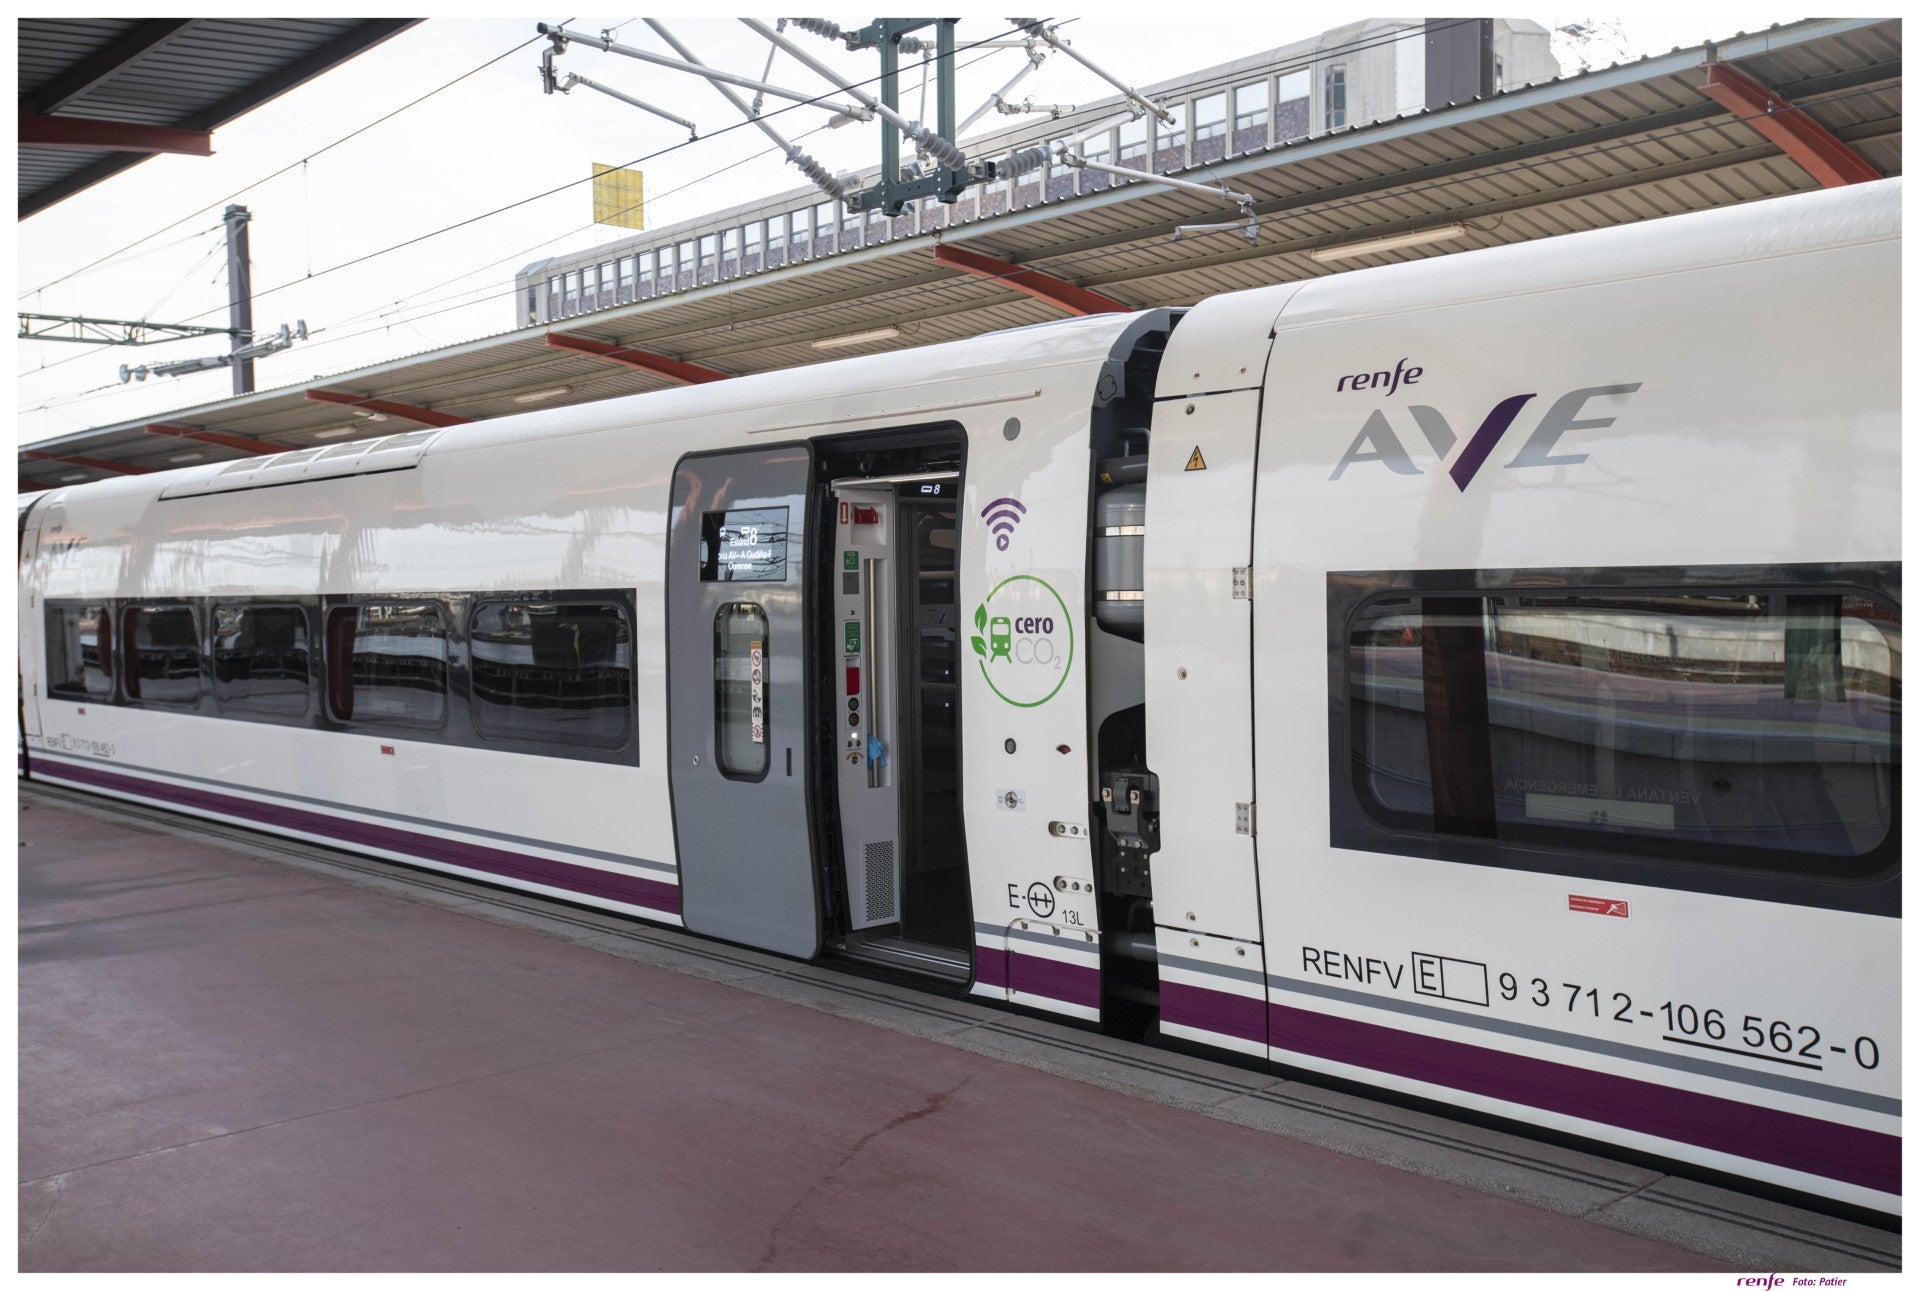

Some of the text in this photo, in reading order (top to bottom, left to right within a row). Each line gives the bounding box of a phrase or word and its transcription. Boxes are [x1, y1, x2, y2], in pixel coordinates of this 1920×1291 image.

[1336, 357, 1424, 397] renfe
[1327, 381, 1645, 493] AVE
[933, 484, 941, 494] 8
[749, 527, 757, 545] 8
[1015, 616, 1054, 634] cero
[1062, 909, 1084, 926] 13L
[1302, 946, 1404, 989] RENFV
[1419, 958, 1437, 991] E
